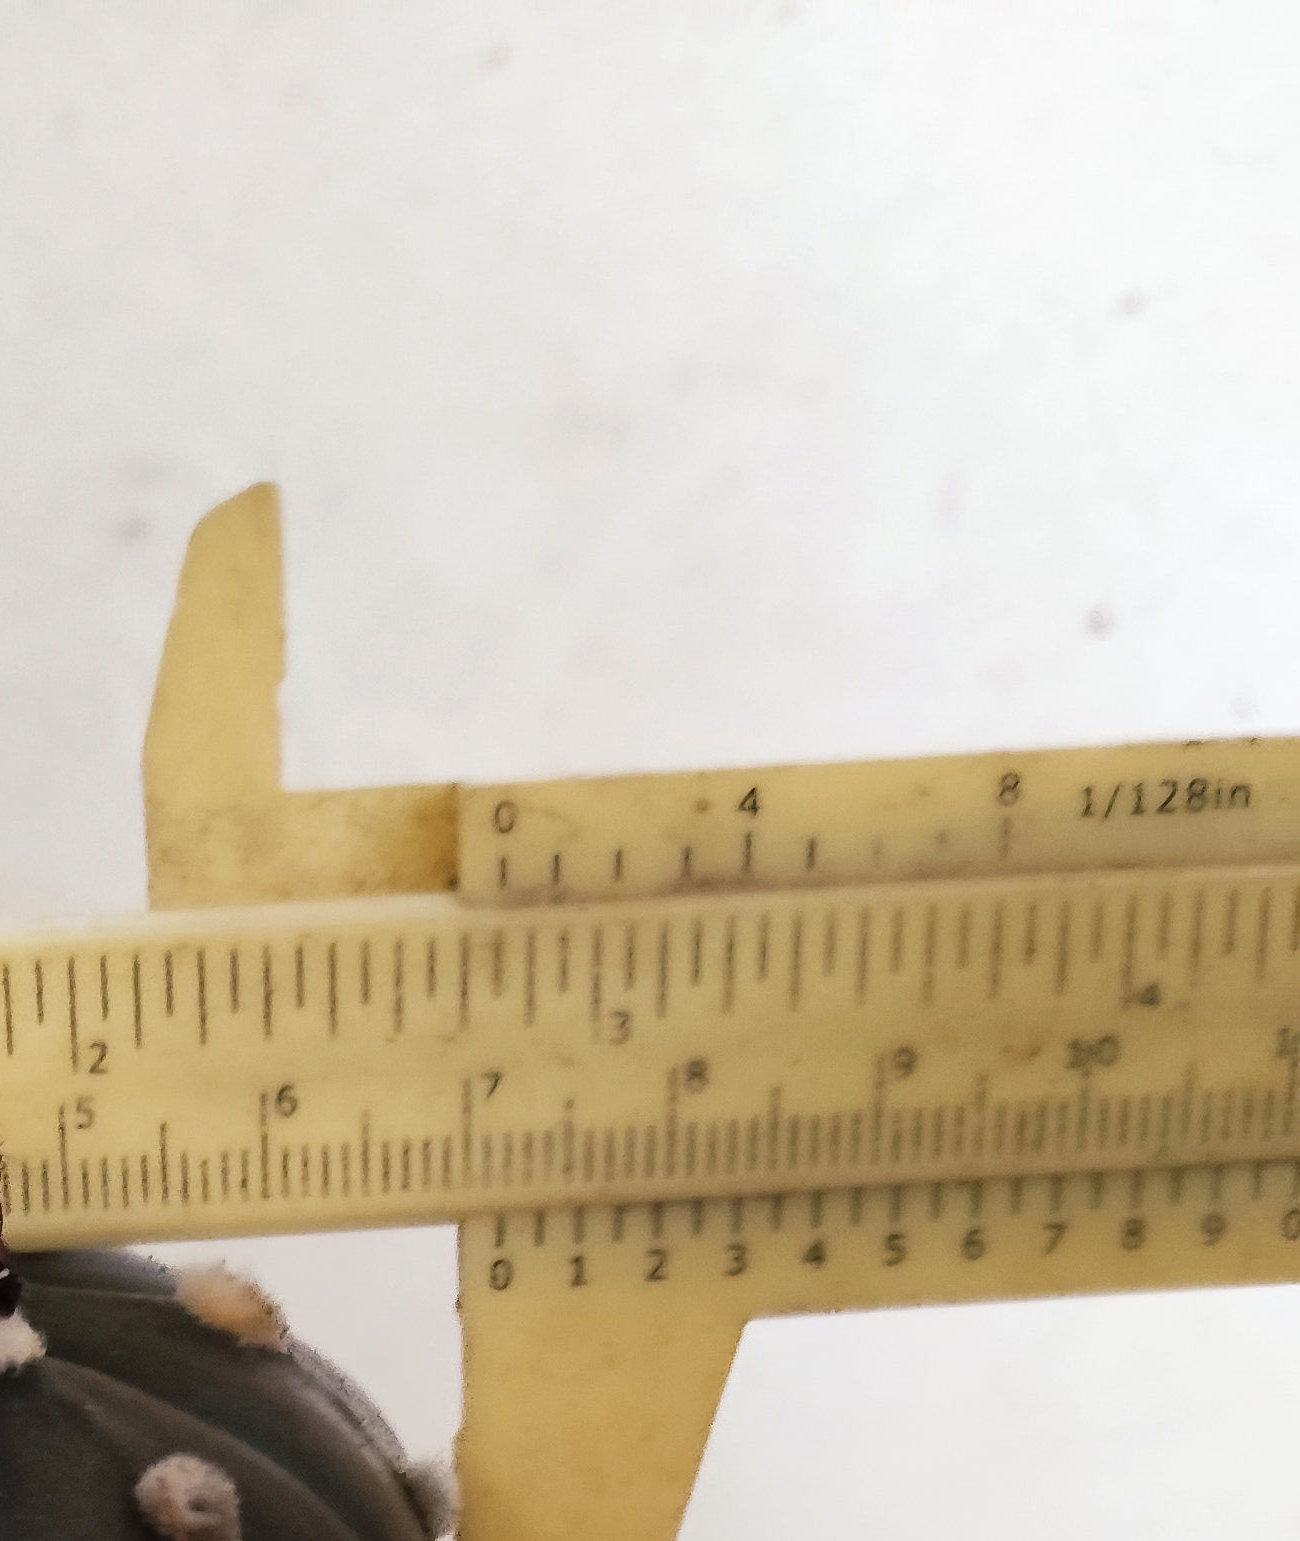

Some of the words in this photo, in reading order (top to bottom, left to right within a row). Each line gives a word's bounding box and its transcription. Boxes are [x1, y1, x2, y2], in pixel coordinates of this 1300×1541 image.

[495, 801, 515, 834] 0
[738, 786, 761, 817] 4
[998, 771, 1022, 805] 8
[1080, 778, 1251, 819] 1/128in
[88, 1041, 110, 1075] 2
[608, 1012, 631, 1043] 3
[75, 1097, 96, 1130] 5
[274, 1084, 298, 1118] 6
[482, 1072, 504, 1101] 7
[682, 1058, 710, 1092] 8
[891, 1046, 917, 1078] 9
[489, 1259, 513, 1291] 0
[570, 1256, 589, 1288] 1
[646, 1250, 670, 1283] 2
[724, 1244, 748, 1276] 3
[803, 1237, 827, 1270] 4
[883, 1233, 908, 1267] 5
[962, 1228, 987, 1261] 6
[1043, 1222, 1067, 1255] 7
[1121, 1217, 1147, 1252] 8
[1202, 1211, 1227, 1246] 9
